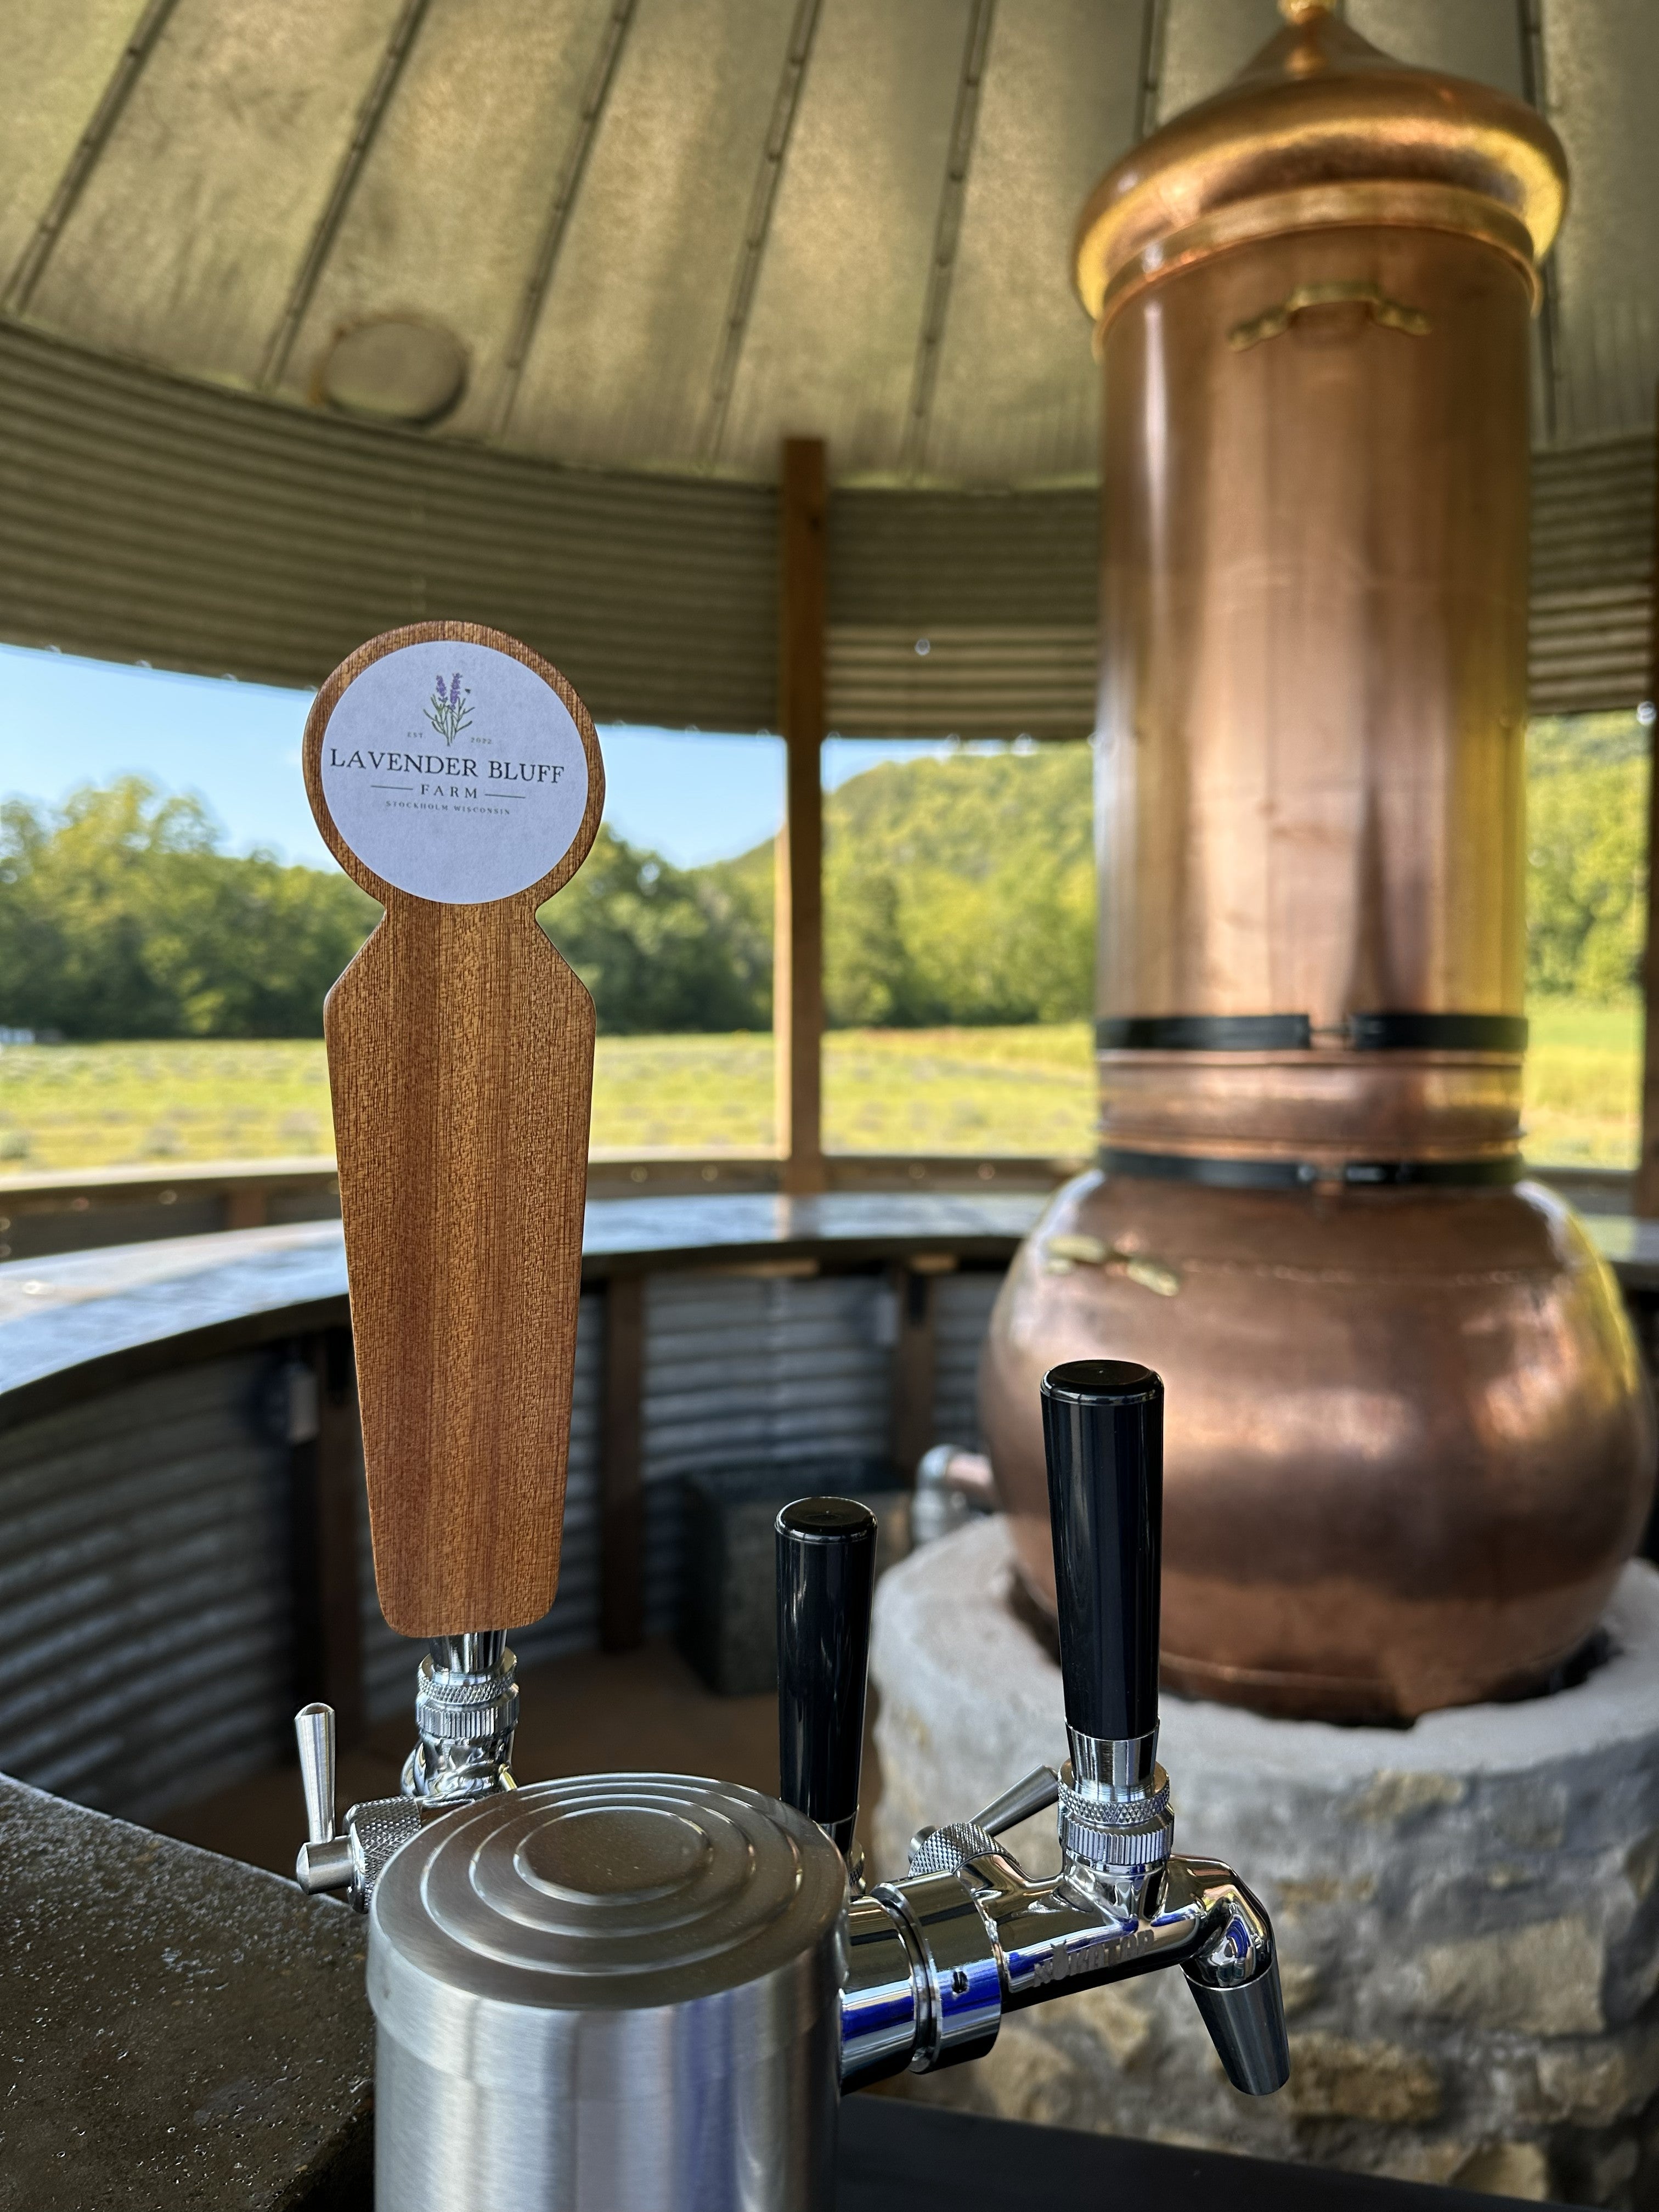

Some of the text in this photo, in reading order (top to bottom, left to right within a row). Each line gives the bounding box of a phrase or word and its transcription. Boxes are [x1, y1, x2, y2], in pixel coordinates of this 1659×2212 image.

[330, 748, 565, 783] LAVENDER BLUFF
[421, 783, 477, 799] FARM
[386, 800, 510, 815] STOCKHOLM WISCONSIN
